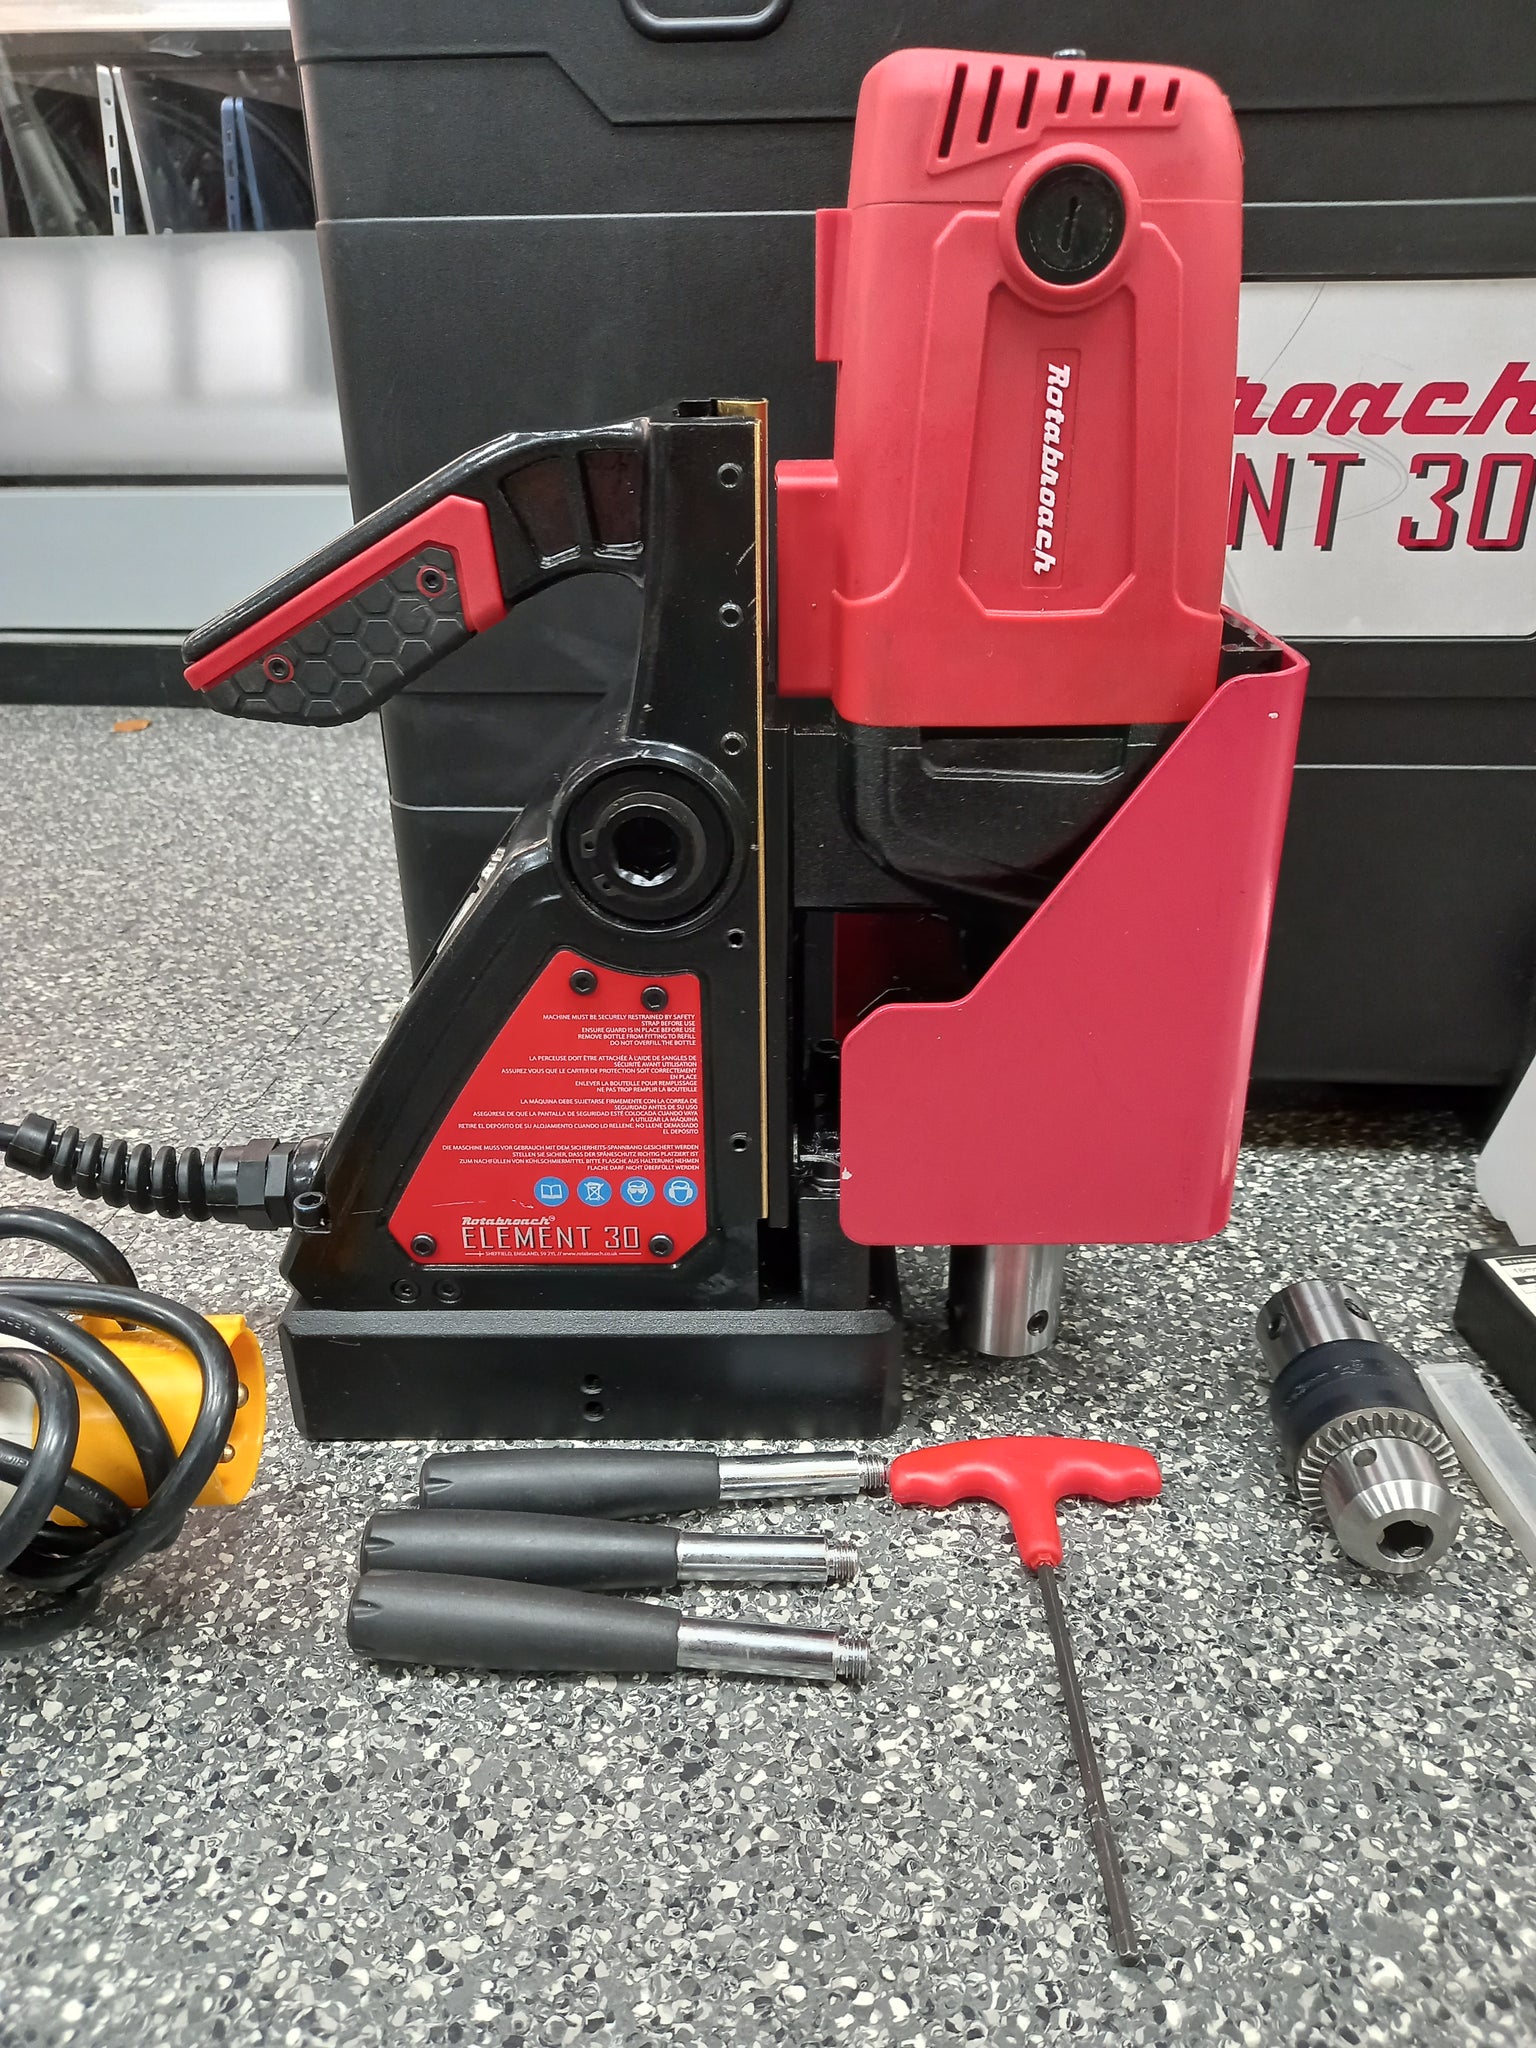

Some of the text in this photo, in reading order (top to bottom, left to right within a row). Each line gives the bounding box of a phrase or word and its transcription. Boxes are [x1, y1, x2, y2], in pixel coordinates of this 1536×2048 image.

[1033, 363, 1071, 575] Rotabroach
[1397, 452, 1536, 552] 30
[462, 1226, 641, 1249] ELEMENT 30
